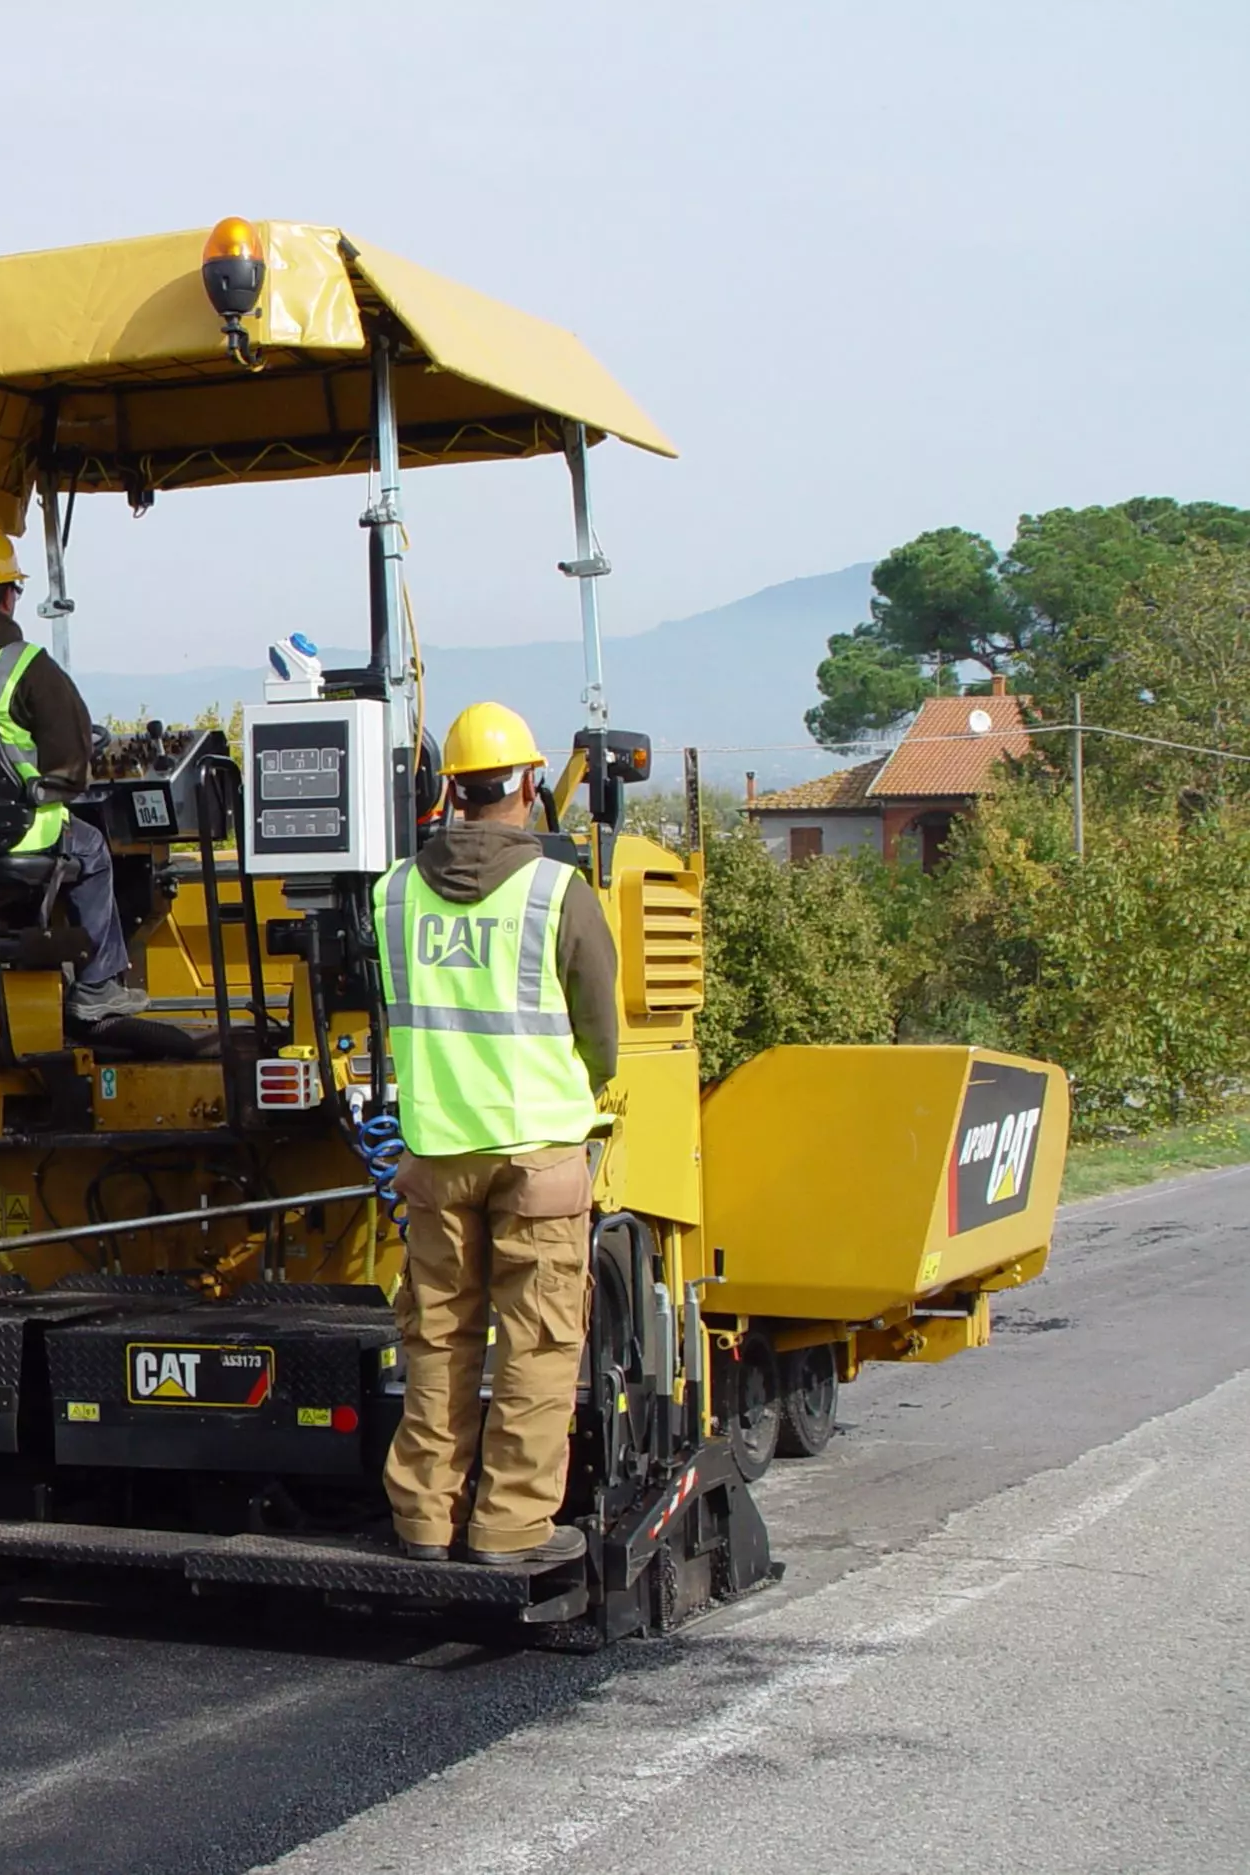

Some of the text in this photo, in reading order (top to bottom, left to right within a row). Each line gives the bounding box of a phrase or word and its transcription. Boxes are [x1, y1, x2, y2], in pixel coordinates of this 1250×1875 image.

[138, 806, 159, 824] 104
[986, 1107, 1040, 1205] CAT
[136, 1352, 201, 1398] CAT
